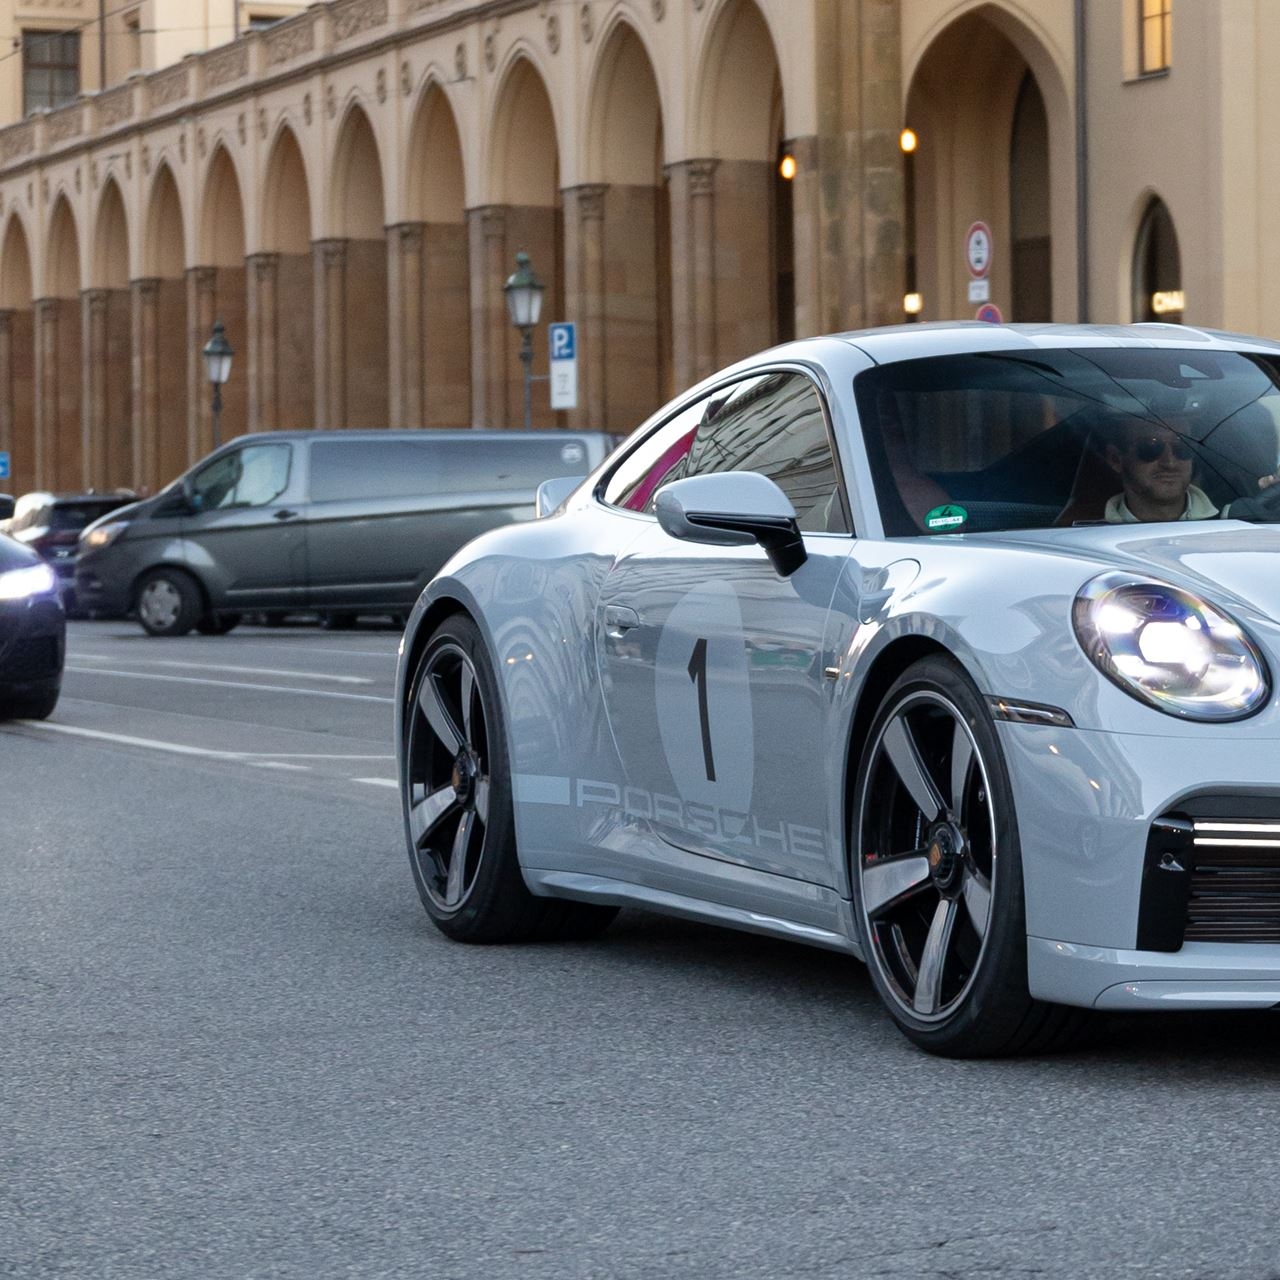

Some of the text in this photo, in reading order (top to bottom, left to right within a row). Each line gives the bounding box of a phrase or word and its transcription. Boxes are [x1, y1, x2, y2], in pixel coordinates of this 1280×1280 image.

[553, 328, 569, 357] P
[688, 638, 716, 782] 1
[576, 778, 825, 861] PORSCHE
